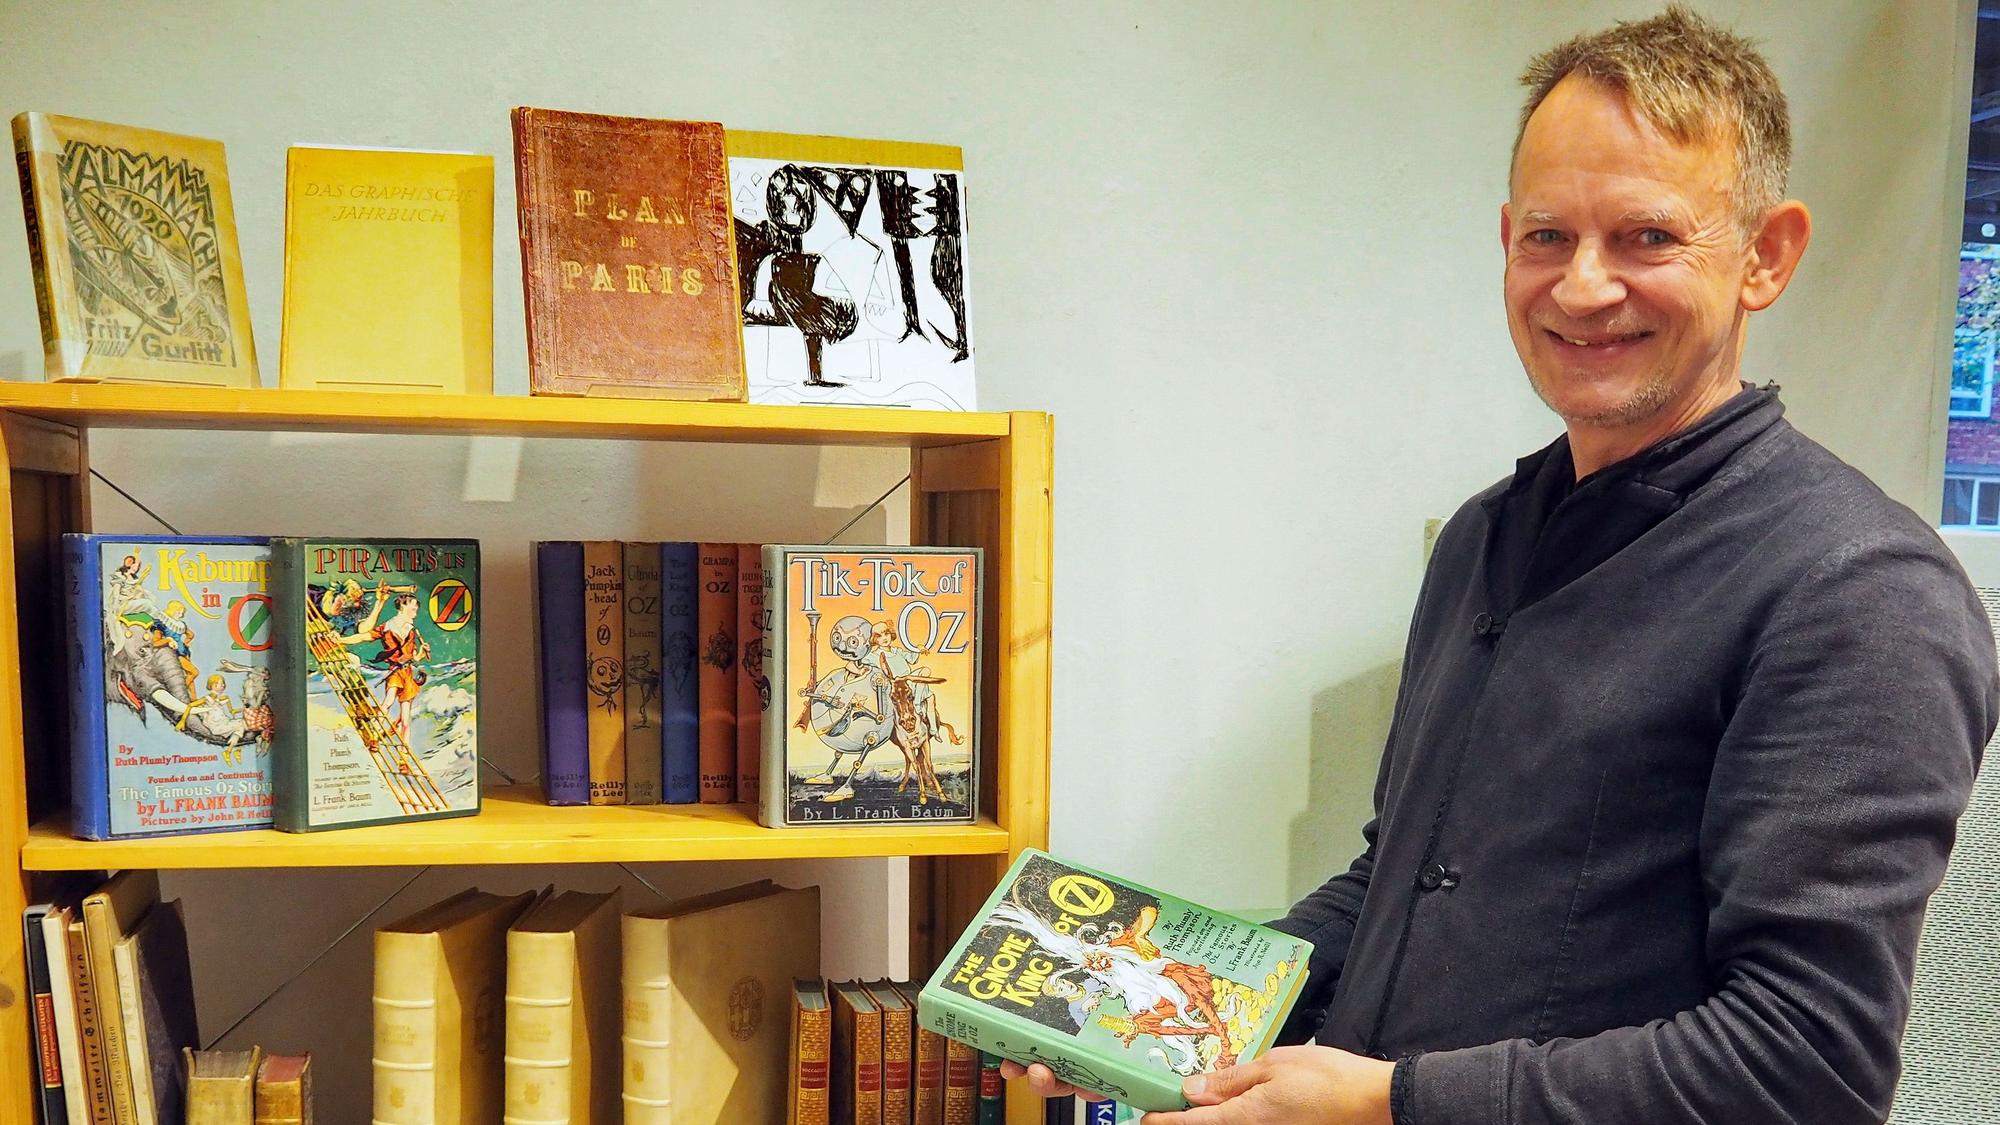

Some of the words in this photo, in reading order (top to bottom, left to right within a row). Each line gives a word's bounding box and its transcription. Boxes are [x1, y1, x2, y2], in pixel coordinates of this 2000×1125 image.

[304, 183, 344, 197] DAS
[350, 184, 478, 202] GRAPHISCHE
[73, 143, 217, 273] ALMANACH
[118, 194, 172, 239] 1920
[332, 206, 448, 222] JAHRBUCH
[574, 189, 685, 224] PLAN
[560, 260, 704, 295] PARIS
[85, 318, 132, 338] Fritz
[141, 333, 223, 361] Gurlitt
[314, 548, 438, 580] PIRATES
[445, 553, 467, 569] IN
[588, 565, 616, 579] Jack
[157, 548, 272, 612] Kabump
[706, 581, 730, 593] OZ
[938, 560, 968, 594] of
[202, 587, 222, 608] in
[628, 597, 657, 615] OZ
[118, 744, 134, 755] By
[115, 757, 138, 767] Ruth
[139, 755, 172, 766] Plumly
[171, 754, 218, 765] Thompson
[147, 775, 185, 784] Founded
[218, 770, 265, 782] Continuing
[590, 781, 625, 790] Reilly
[703, 774, 733, 783] Reilly
[120, 787, 149, 801] The
[155, 785, 212, 799] Famous
[216, 782, 236, 794] Oz
[323, 794, 346, 804] Frank
[349, 793, 372, 801] Baum
[603, 789, 624, 797] Lee
[137, 801, 157, 816] by
[231, 793, 274, 809] BAUM
[854, 806, 900, 819] Frank
[911, 805, 954, 818] Baum
[140, 816, 187, 826] Pictures
[191, 815, 204, 825] by
[208, 813, 234, 823] John
[1054, 912, 1082, 933] OF
[1162, 920, 1174, 931] By
[1163, 934, 1179, 951] Ruth
[1174, 908, 1195, 934] Plumly
[1204, 915, 1213, 927] and
[1172, 911, 1202, 953] Thompson
[1209, 925, 1228, 950] Famous
[1218, 923, 1237, 950] Stories
[1241, 929, 1258, 948] Baum
[952, 952, 985, 985] THE
[968, 933, 1034, 1000] GNOME
[1000, 958, 1054, 1008] KING
